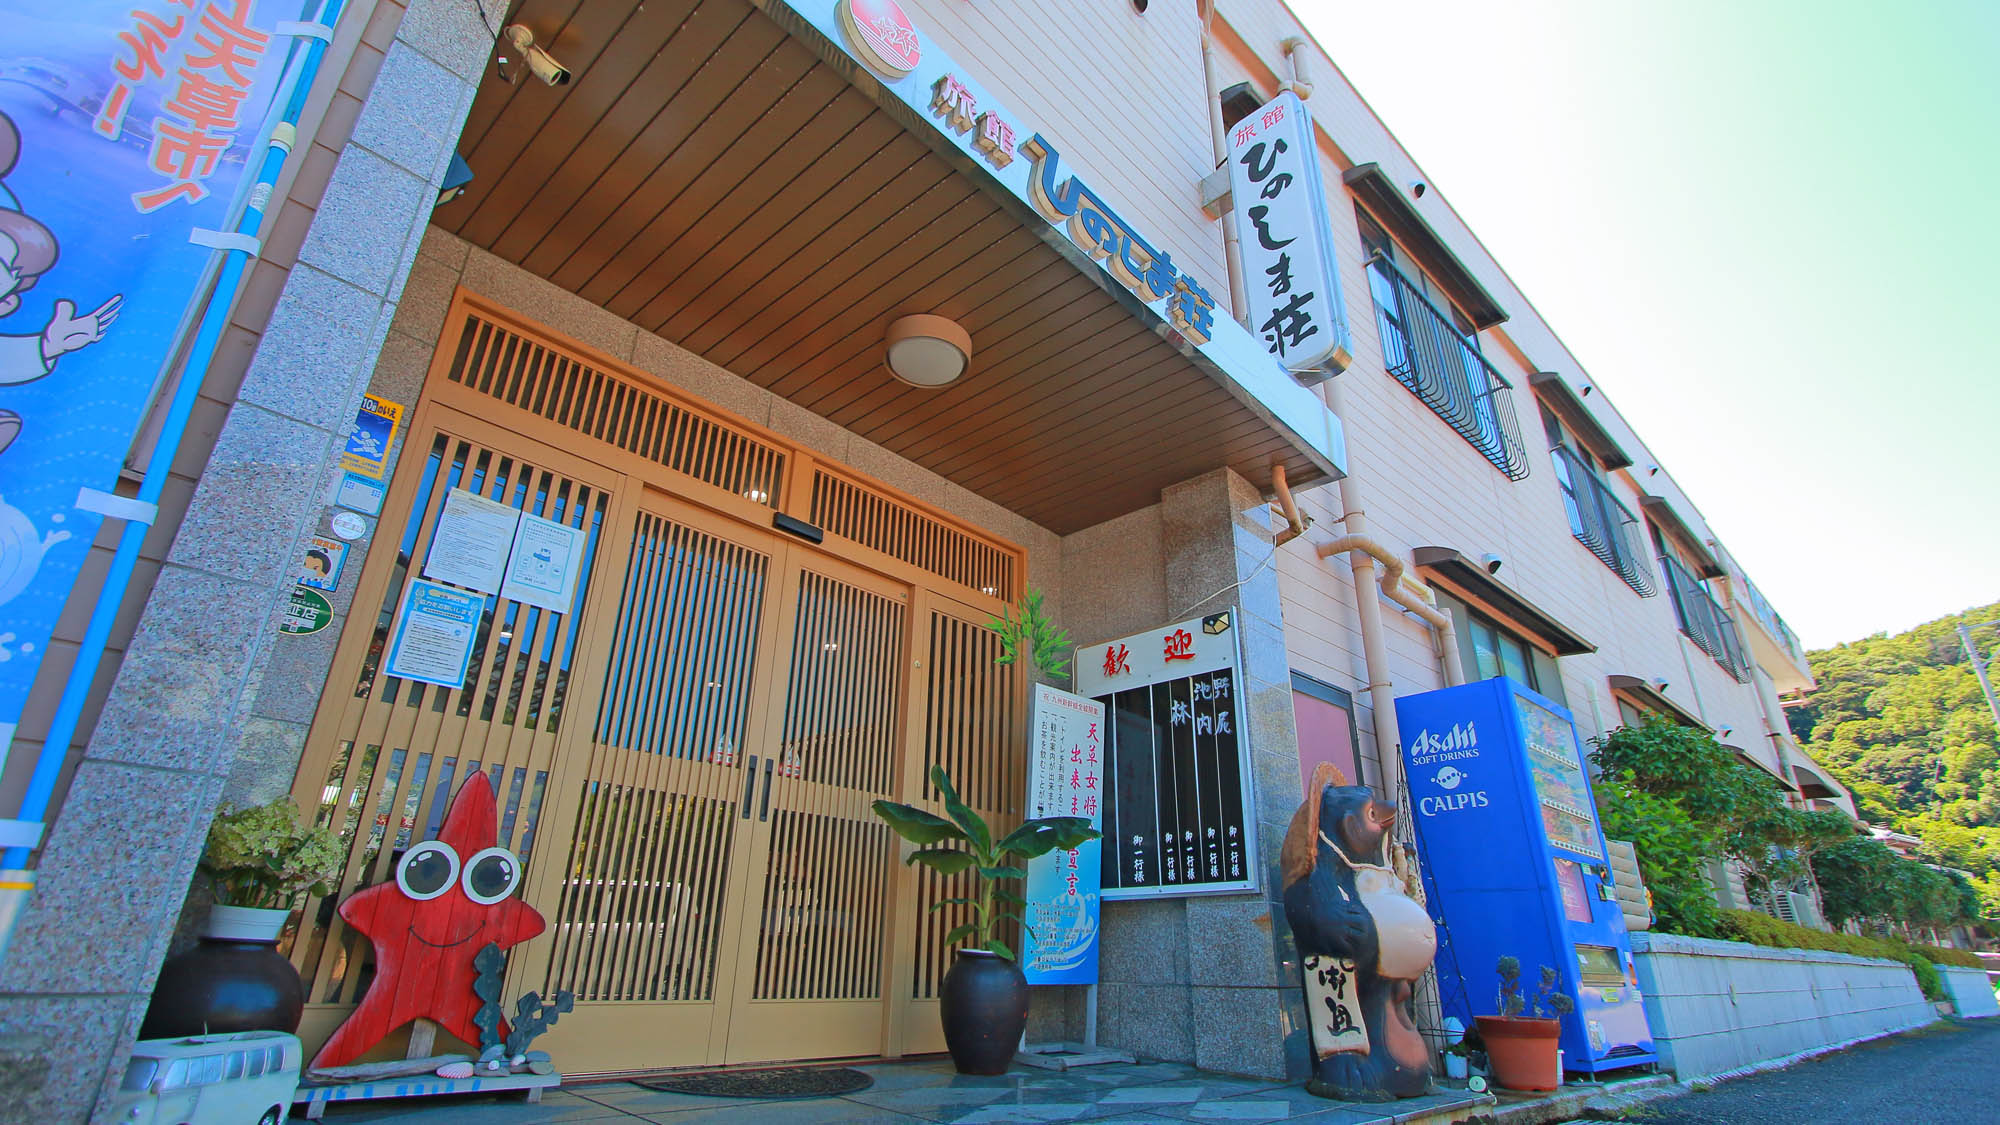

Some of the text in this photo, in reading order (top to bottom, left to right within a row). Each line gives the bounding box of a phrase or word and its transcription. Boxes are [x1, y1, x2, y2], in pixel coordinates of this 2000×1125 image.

[1235, 104, 1285, 148] 旅館
[932, 72, 1215, 347] 旅館 ひのしま荘
[1240, 137, 1318, 359] ひのしま荘
[1410, 720, 1477, 757] Asahi
[1412, 747, 1480, 766] SOFT DRINKS
[1084, 722, 1099, 841] 天草女将
[1170, 699, 1196, 880] 林 御一行様
[1193, 681, 1219, 878] 池内 御一行様
[1420, 790, 1489, 817] CALPIS
[1065, 743, 1083, 896] 出来ま宣言
[1132, 834, 1145, 883] 御一行様
[1165, 832, 1176, 882] 御一行様
[1228, 825, 1240, 878] 御一行様
